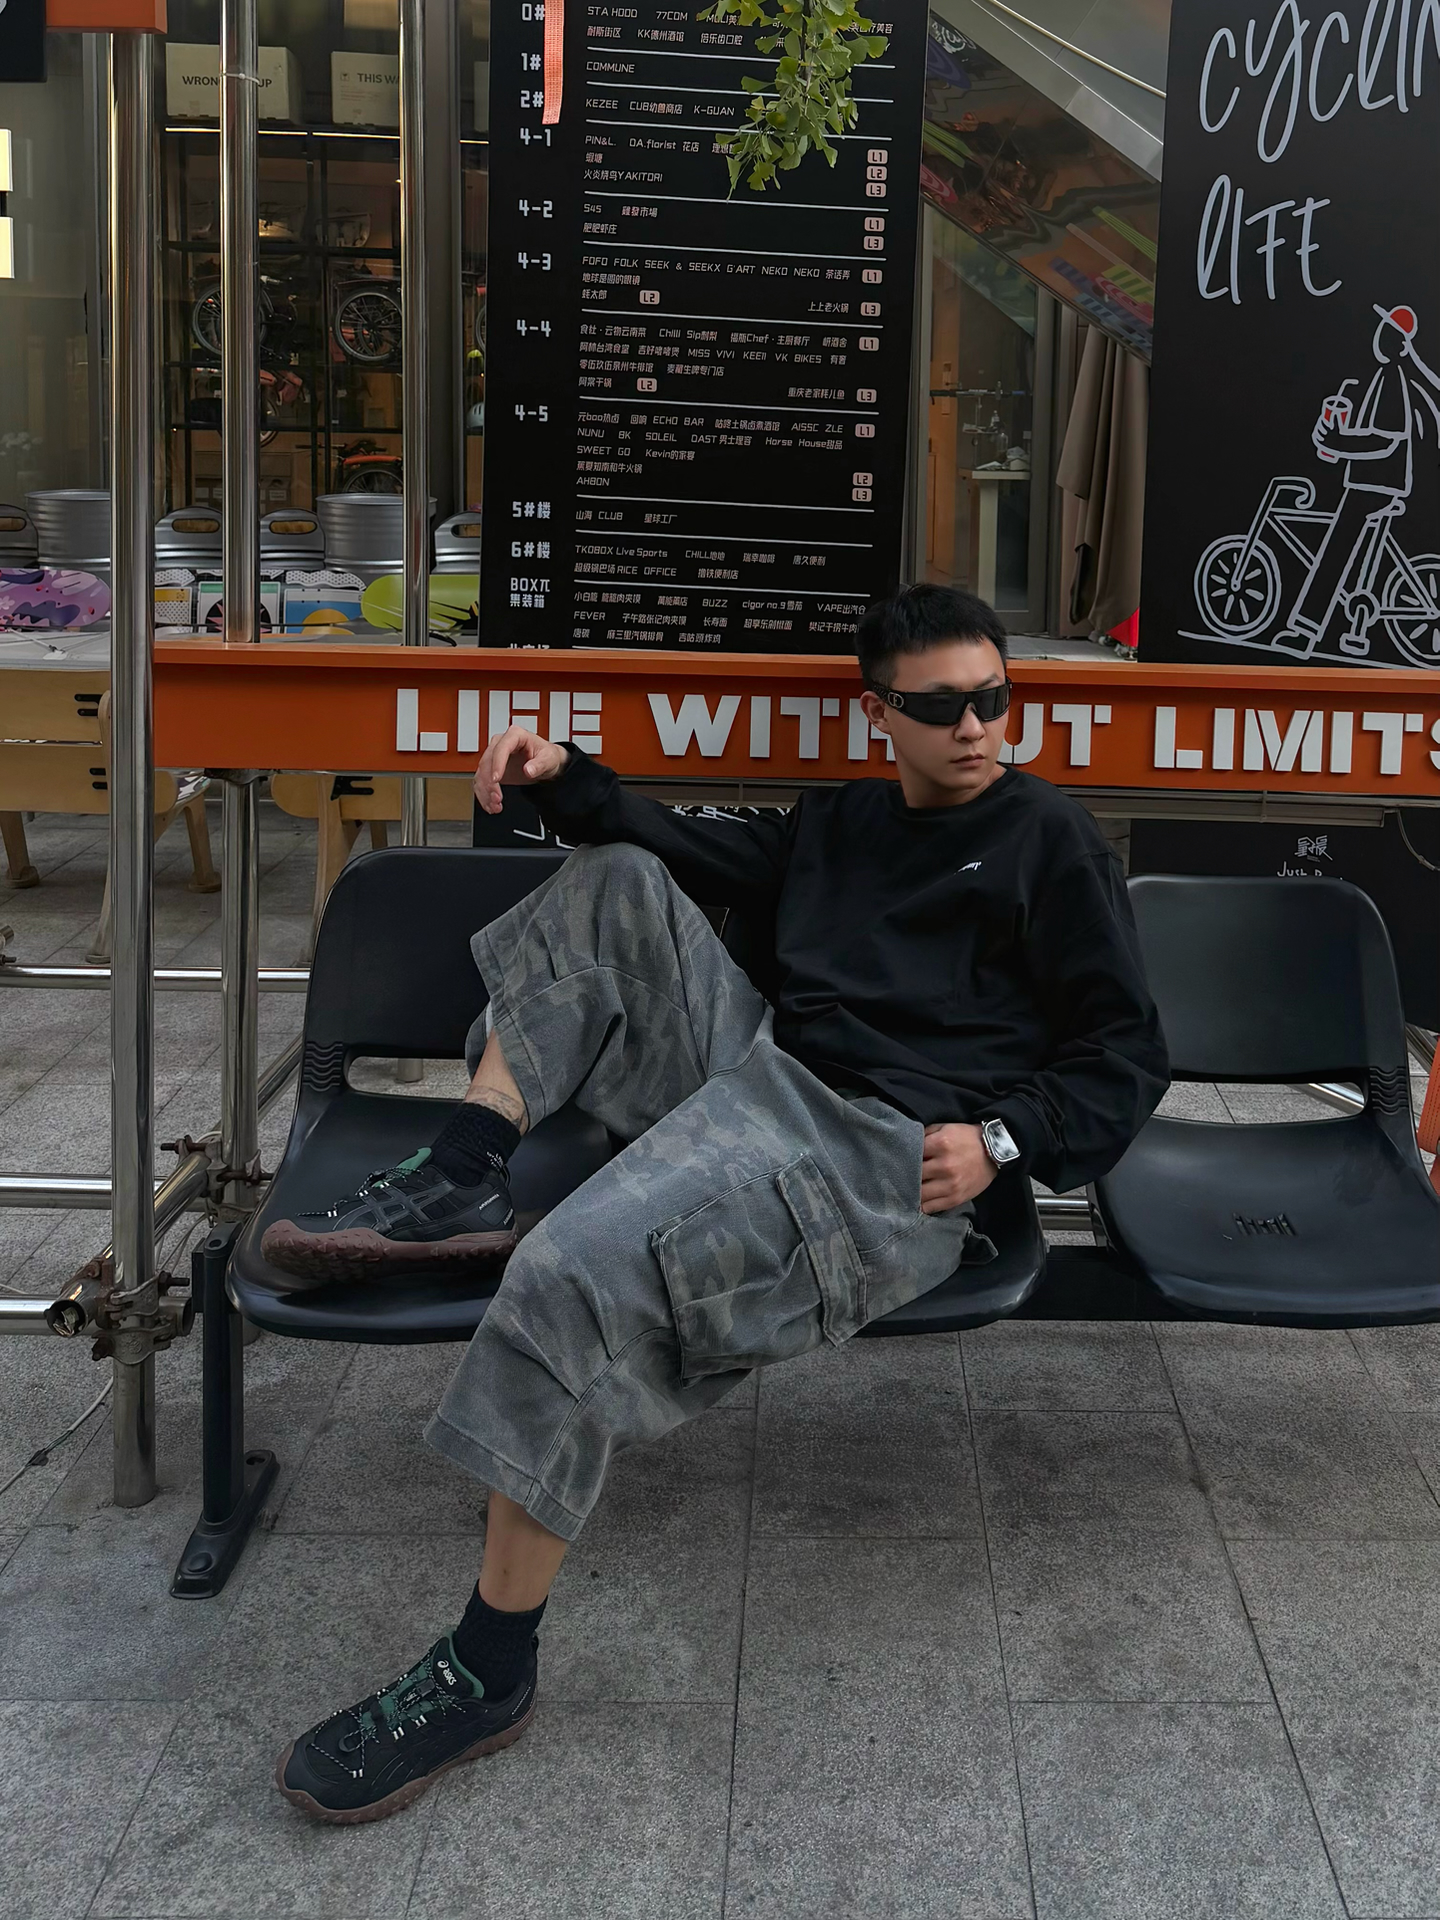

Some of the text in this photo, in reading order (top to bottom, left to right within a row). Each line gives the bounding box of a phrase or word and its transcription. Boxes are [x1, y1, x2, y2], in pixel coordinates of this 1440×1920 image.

[588, 6, 608, 16] STA
[611, 8, 637, 17] HOOD
[656, 11, 688, 20] 77COM
[521, 53, 541, 70] 1#
[587, 62, 635, 73] COMMUNE
[182, 76, 219, 86] WRON
[357, 72, 382, 84] THIS
[520, 91, 543, 109] 2#
[586, 99, 618, 109] KEZEE
[694, 105, 734, 116] K-GUAN
[520, 128, 550, 146] 4-1
[585, 135, 616, 145] PIN&L.
[872, 151, 883, 163] L1
[870, 168, 883, 179] L2
[869, 184, 882, 196] L3
[519, 200, 552, 218] 4-2
[869, 219, 880, 230] L1
[867, 238, 880, 249] L3
[518, 252, 551, 270] 4-3
[582, 256, 608, 266] FOFO
[614, 258, 638, 267] FOLK
[645, 260, 669, 269] SEEK
[689, 262, 720, 272] SEEKX
[762, 266, 788, 275] NEKO
[794, 268, 820, 277] NEKO
[866, 271, 877, 282] L1
[643, 292, 656, 303] L2
[808, 302, 877, 315] 上上老火锅 L3
[517, 320, 551, 337] 4-4
[863, 338, 874, 350] L1
[688, 349, 710, 357] MISS
[717, 350, 735, 358] VIVI
[775, 353, 788, 362] VK
[794, 354, 822, 363] BIKES
[640, 379, 653, 391] L2
[860, 390, 873, 402] L3
[515, 405, 548, 422] 4-5
[653, 416, 678, 425] ECHO
[684, 417, 704, 426] BAR
[791, 423, 819, 431] AISSC
[825, 424, 843, 433] ZLE
[859, 425, 870, 436] L1
[577, 428, 604, 437] NUNU
[645, 432, 677, 442] SOLEIL
[577, 445, 612, 455] SWEET
[618, 447, 630, 456] GO
[856, 474, 869, 485] L2
[855, 489, 868, 500] L3
[513, 501, 550, 519] 5#楼
[598, 511, 623, 520] CLUB
[644, 514, 677, 524] 星球工厂
[512, 542, 550, 559] 6#楼
[616, 547, 635, 556] Live
[637, 548, 667, 558] Sports
[617, 566, 638, 574] RICE
[644, 567, 677, 576] OFFICE
[702, 599, 728, 608] BUZZ
[574, 611, 605, 620] FEVER
[1154, 706, 1440, 775] LIMIT
